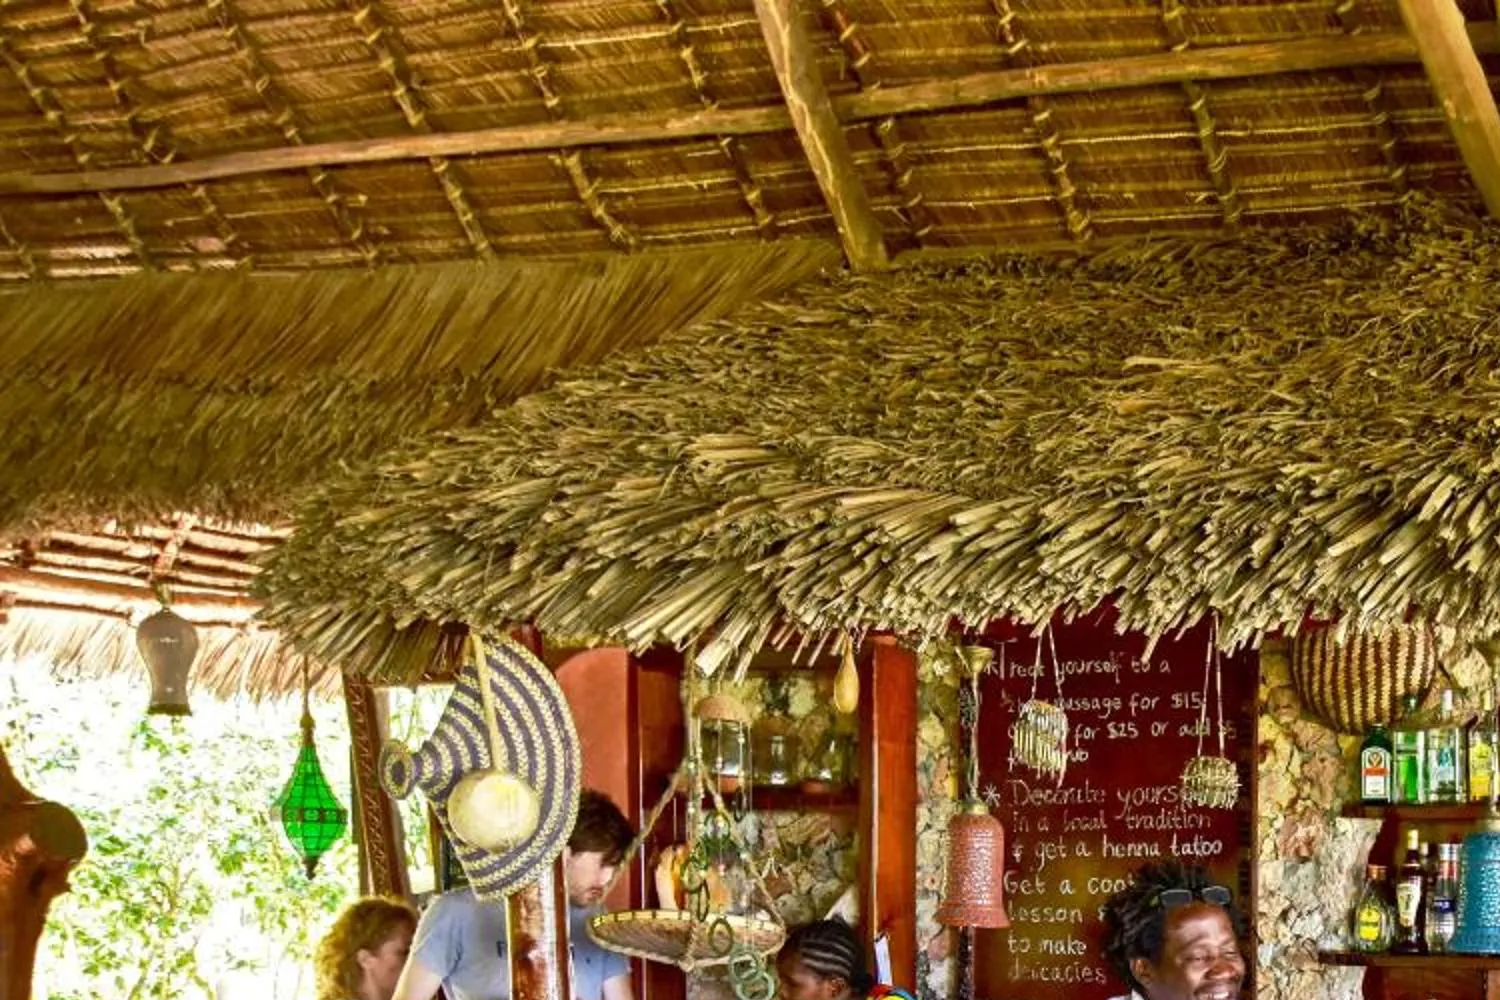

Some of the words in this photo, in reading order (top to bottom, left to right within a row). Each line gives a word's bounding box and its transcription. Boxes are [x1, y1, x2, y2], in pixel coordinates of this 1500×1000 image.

[1160, 660, 1171, 674] a
[1129, 692, 1160, 717] for
[1171, 691, 1202, 710] $15
[1073, 723, 1100, 748] for
[1106, 721, 1139, 739] $25
[1116, 782, 1190, 819] yours
[1124, 806, 1212, 832] tradition
[1034, 836, 1067, 873] get
[1075, 841, 1092, 858] a
[1102, 833, 1161, 859] henna
[1003, 869, 1046, 896] Get
[1059, 879, 1076, 896] a
[1087, 872, 1136, 895] coo
[1007, 900, 1084, 924] lesson
[1008, 931, 1031, 954] to
[1039, 934, 1087, 956] make
